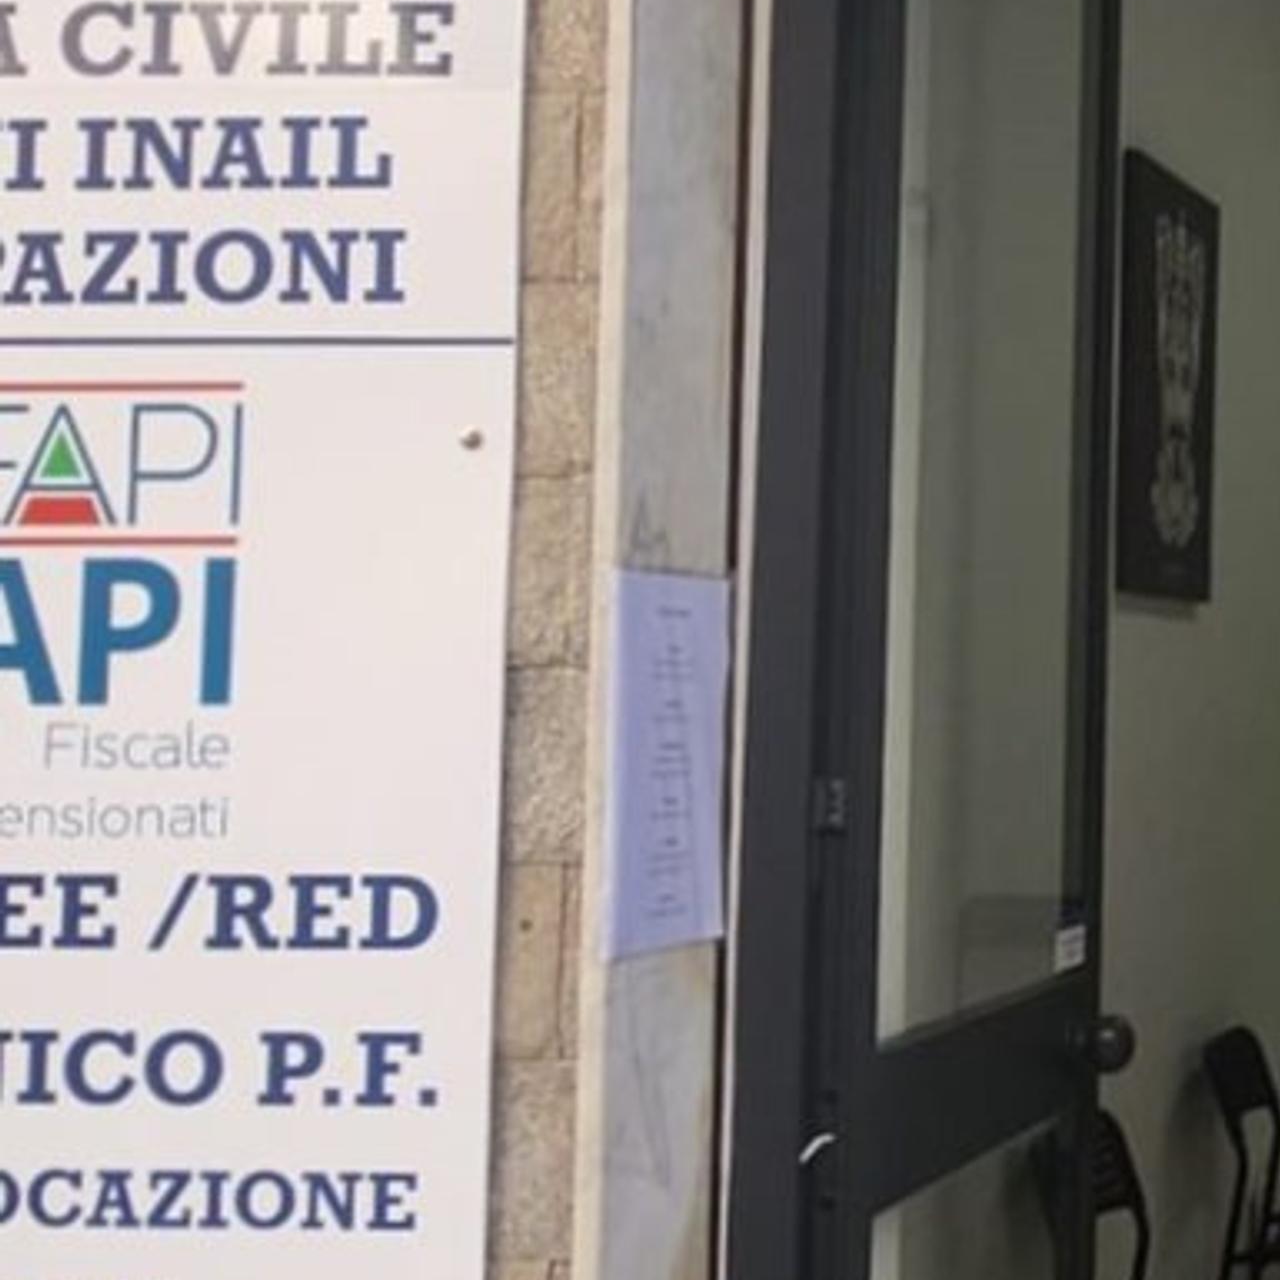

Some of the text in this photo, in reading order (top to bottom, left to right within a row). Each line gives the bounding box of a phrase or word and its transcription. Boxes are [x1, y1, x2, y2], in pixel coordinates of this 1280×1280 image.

[61, 1, 455, 78] CIVILE
[74, 118, 393, 191] INAIL
[0, 230, 407, 305] AZIONI
[43, 721, 231, 770] Fiscale
[0, 797, 230, 839] ensionati
[149, 872, 441, 951] /RED
[0, 1029, 440, 1107] ICO P.F.
